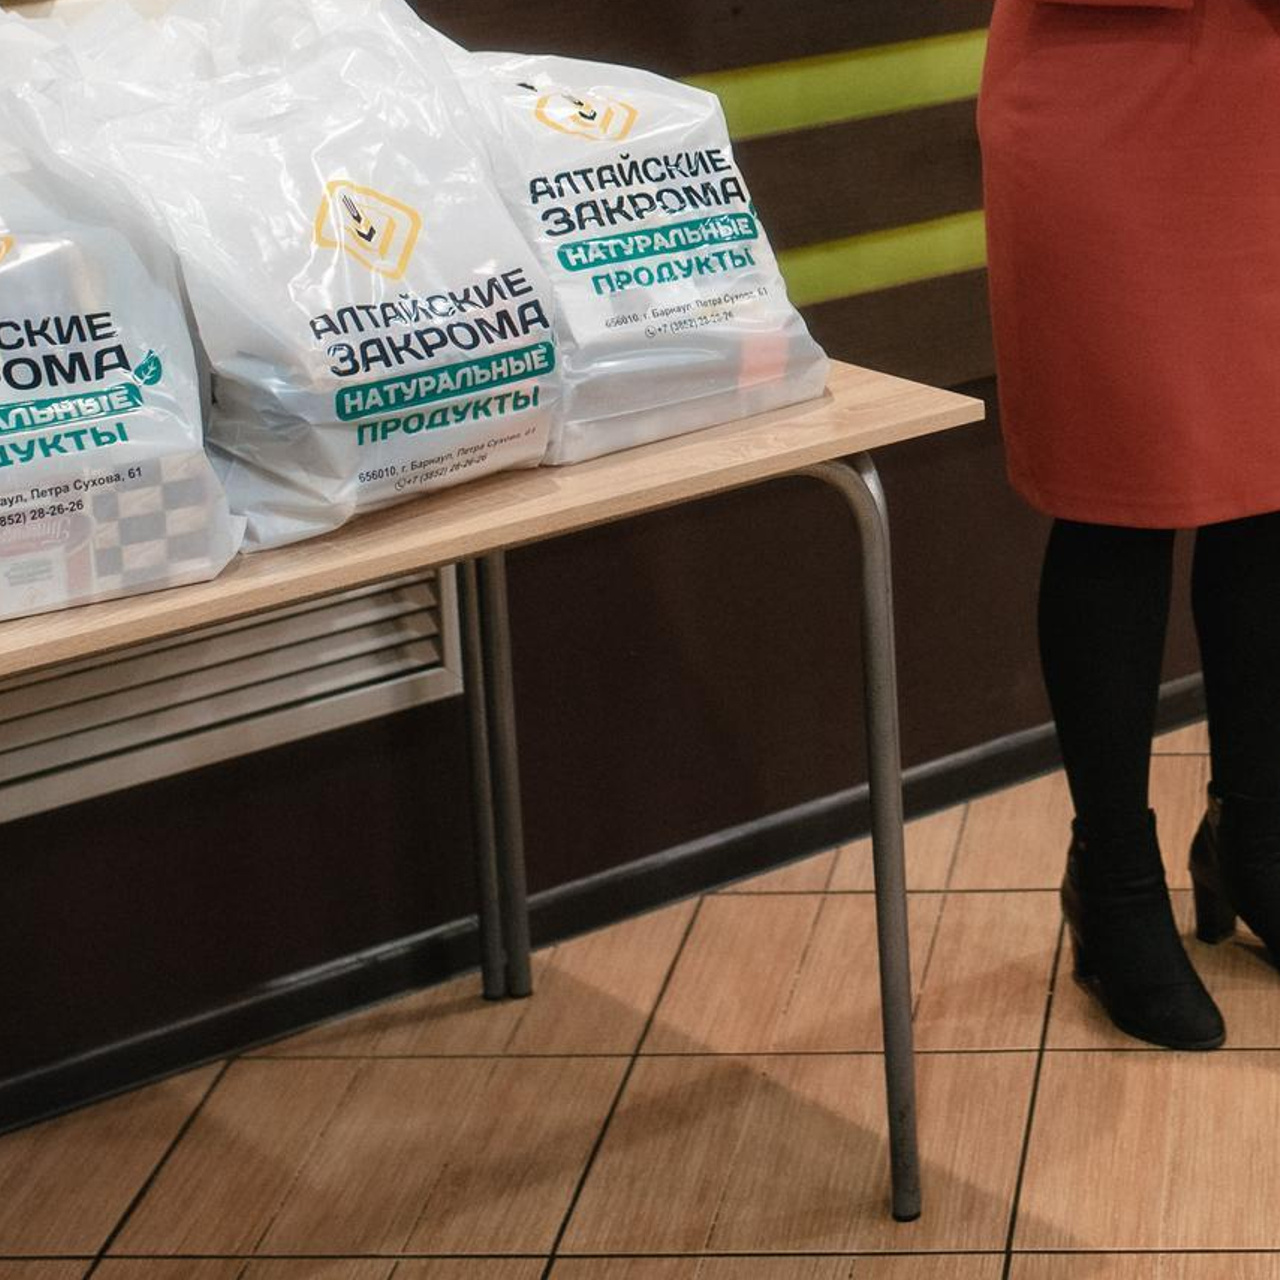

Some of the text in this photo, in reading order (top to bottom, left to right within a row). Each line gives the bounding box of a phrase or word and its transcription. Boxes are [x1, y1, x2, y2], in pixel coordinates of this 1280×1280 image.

[529, 149, 732, 204] АЛТАЙСКИЕ
[541, 176, 747, 237] ЗАКРОМА
[563, 216, 753, 266] НАТУРАЛЬНЫЕ
[591, 248, 756, 295] ПРОДУКТЫ
[309, 268, 533, 341] АЛТАЙСКИЕ
[0, 312, 117, 350] СКИЕ
[327, 299, 550, 377] ЗАКРОМА
[343, 344, 550, 414] НАТУРАЛЬНЫЕ
[357, 385, 540, 446] ПРОДУКТЫ
[30, 484, 70, 500] Петра
[73, 474, 125, 492] Сухова,
[128, 467, 142, 479] 61
[358, 464, 399, 484] 656010,
[29, 499, 84, 521] 28-26-26
